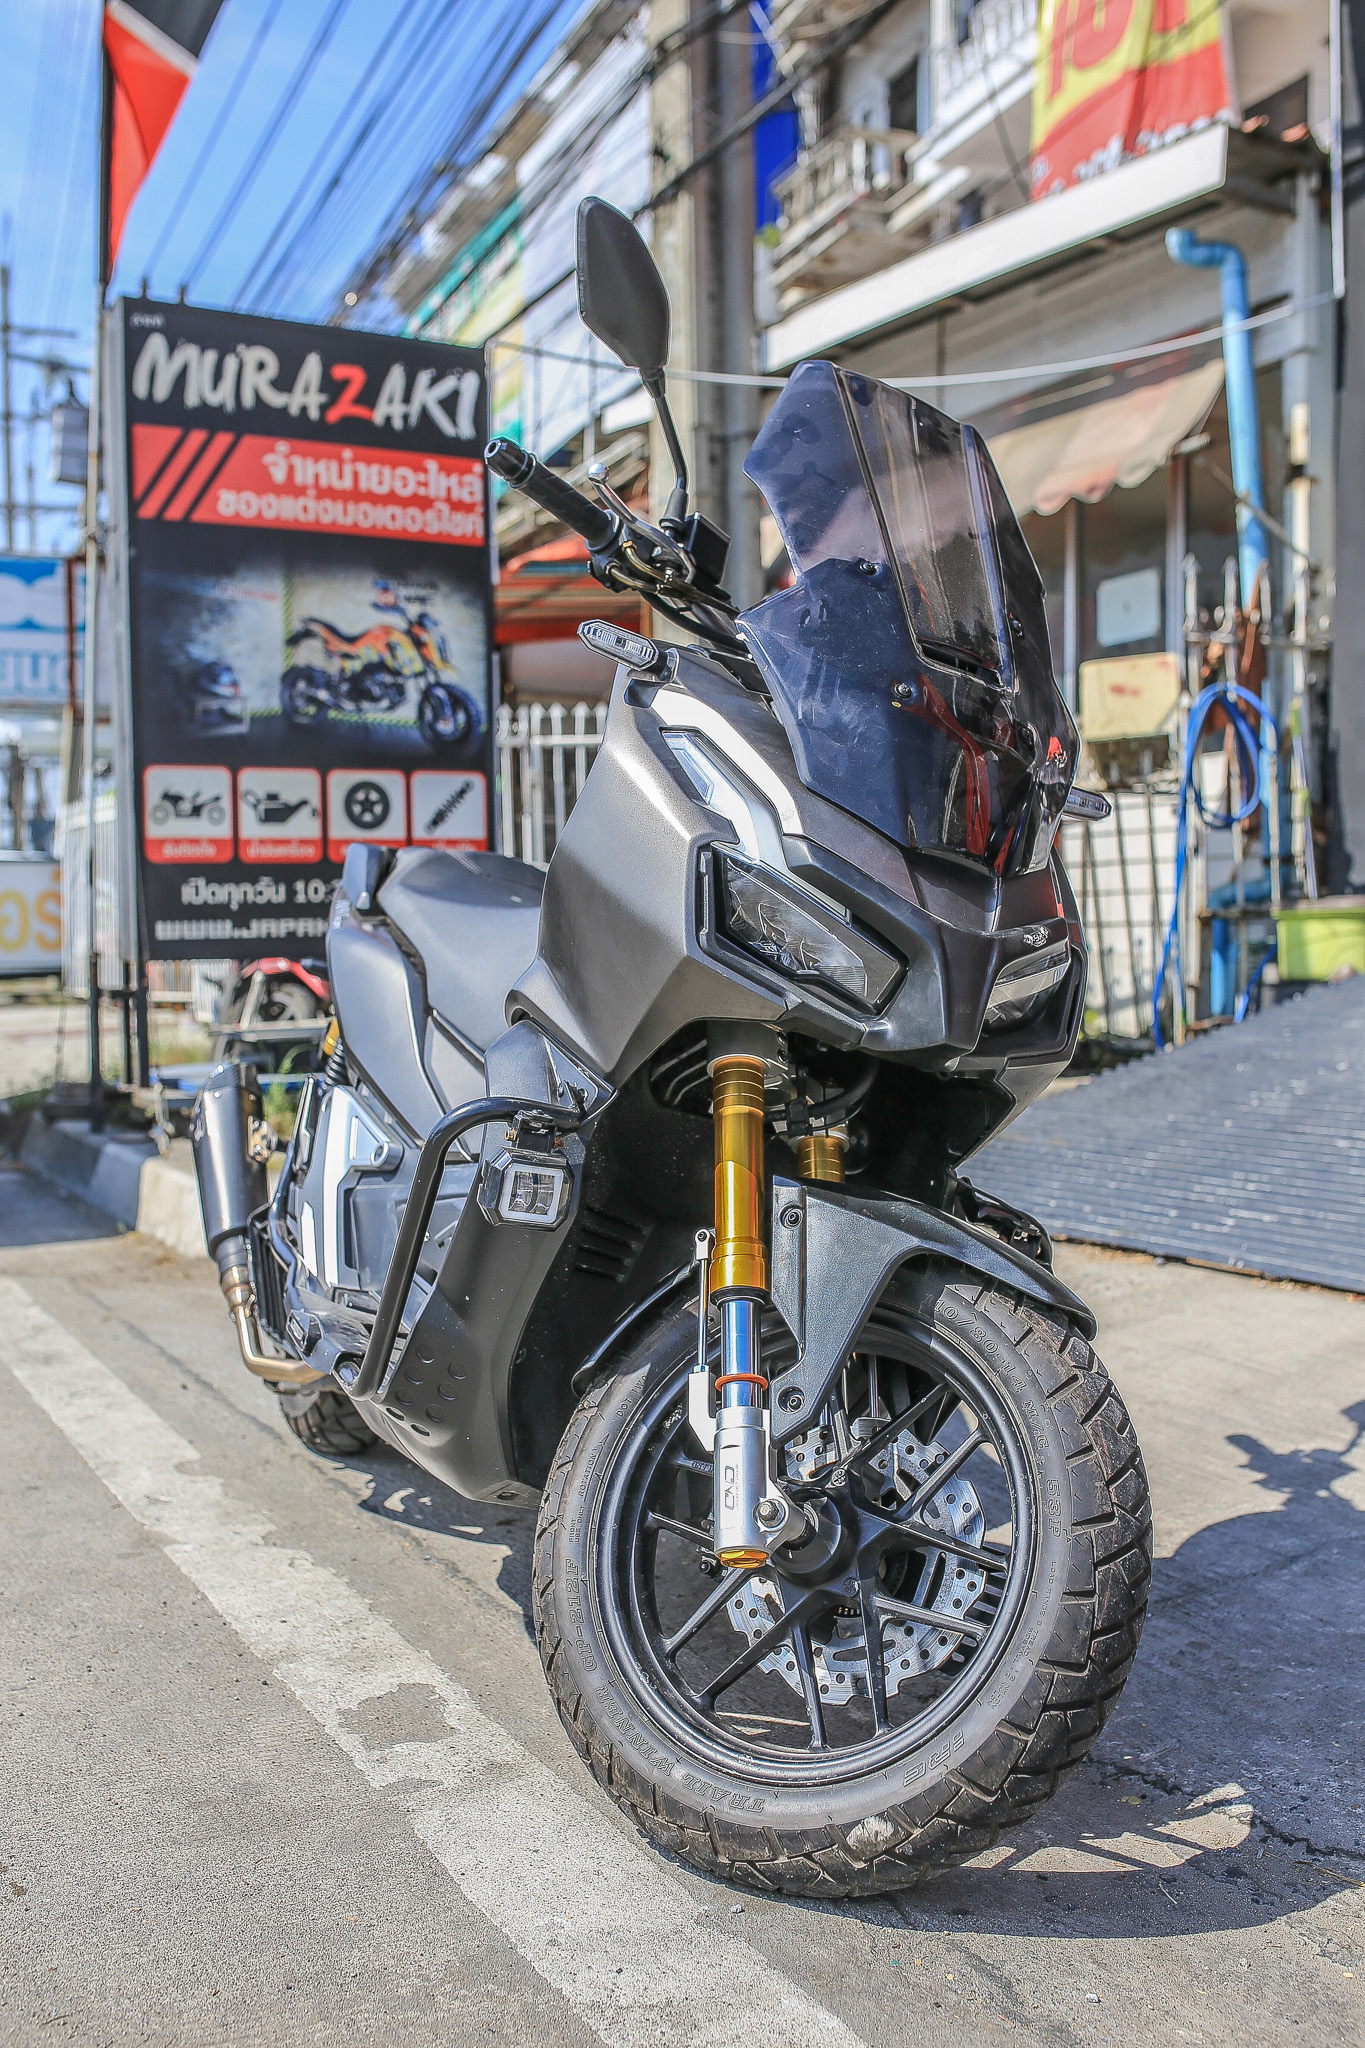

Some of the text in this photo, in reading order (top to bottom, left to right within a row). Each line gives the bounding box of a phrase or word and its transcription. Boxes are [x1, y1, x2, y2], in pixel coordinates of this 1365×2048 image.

[263, 441, 484, 505] จำหน่ายอะไหล่
[181, 876, 287, 911] เปิดทุกวัน
[616, 1393, 632, 1418] DOT
[578, 1453, 598, 1497] ROTATION
[568, 1517, 578, 1543] FRONT
[577, 1504, 585, 1524] ONLY
[1046, 1478, 1061, 1538] 53P
[565, 1558, 598, 1672] GP-212F
[595, 1685, 766, 1814] TRAIL WINNER
